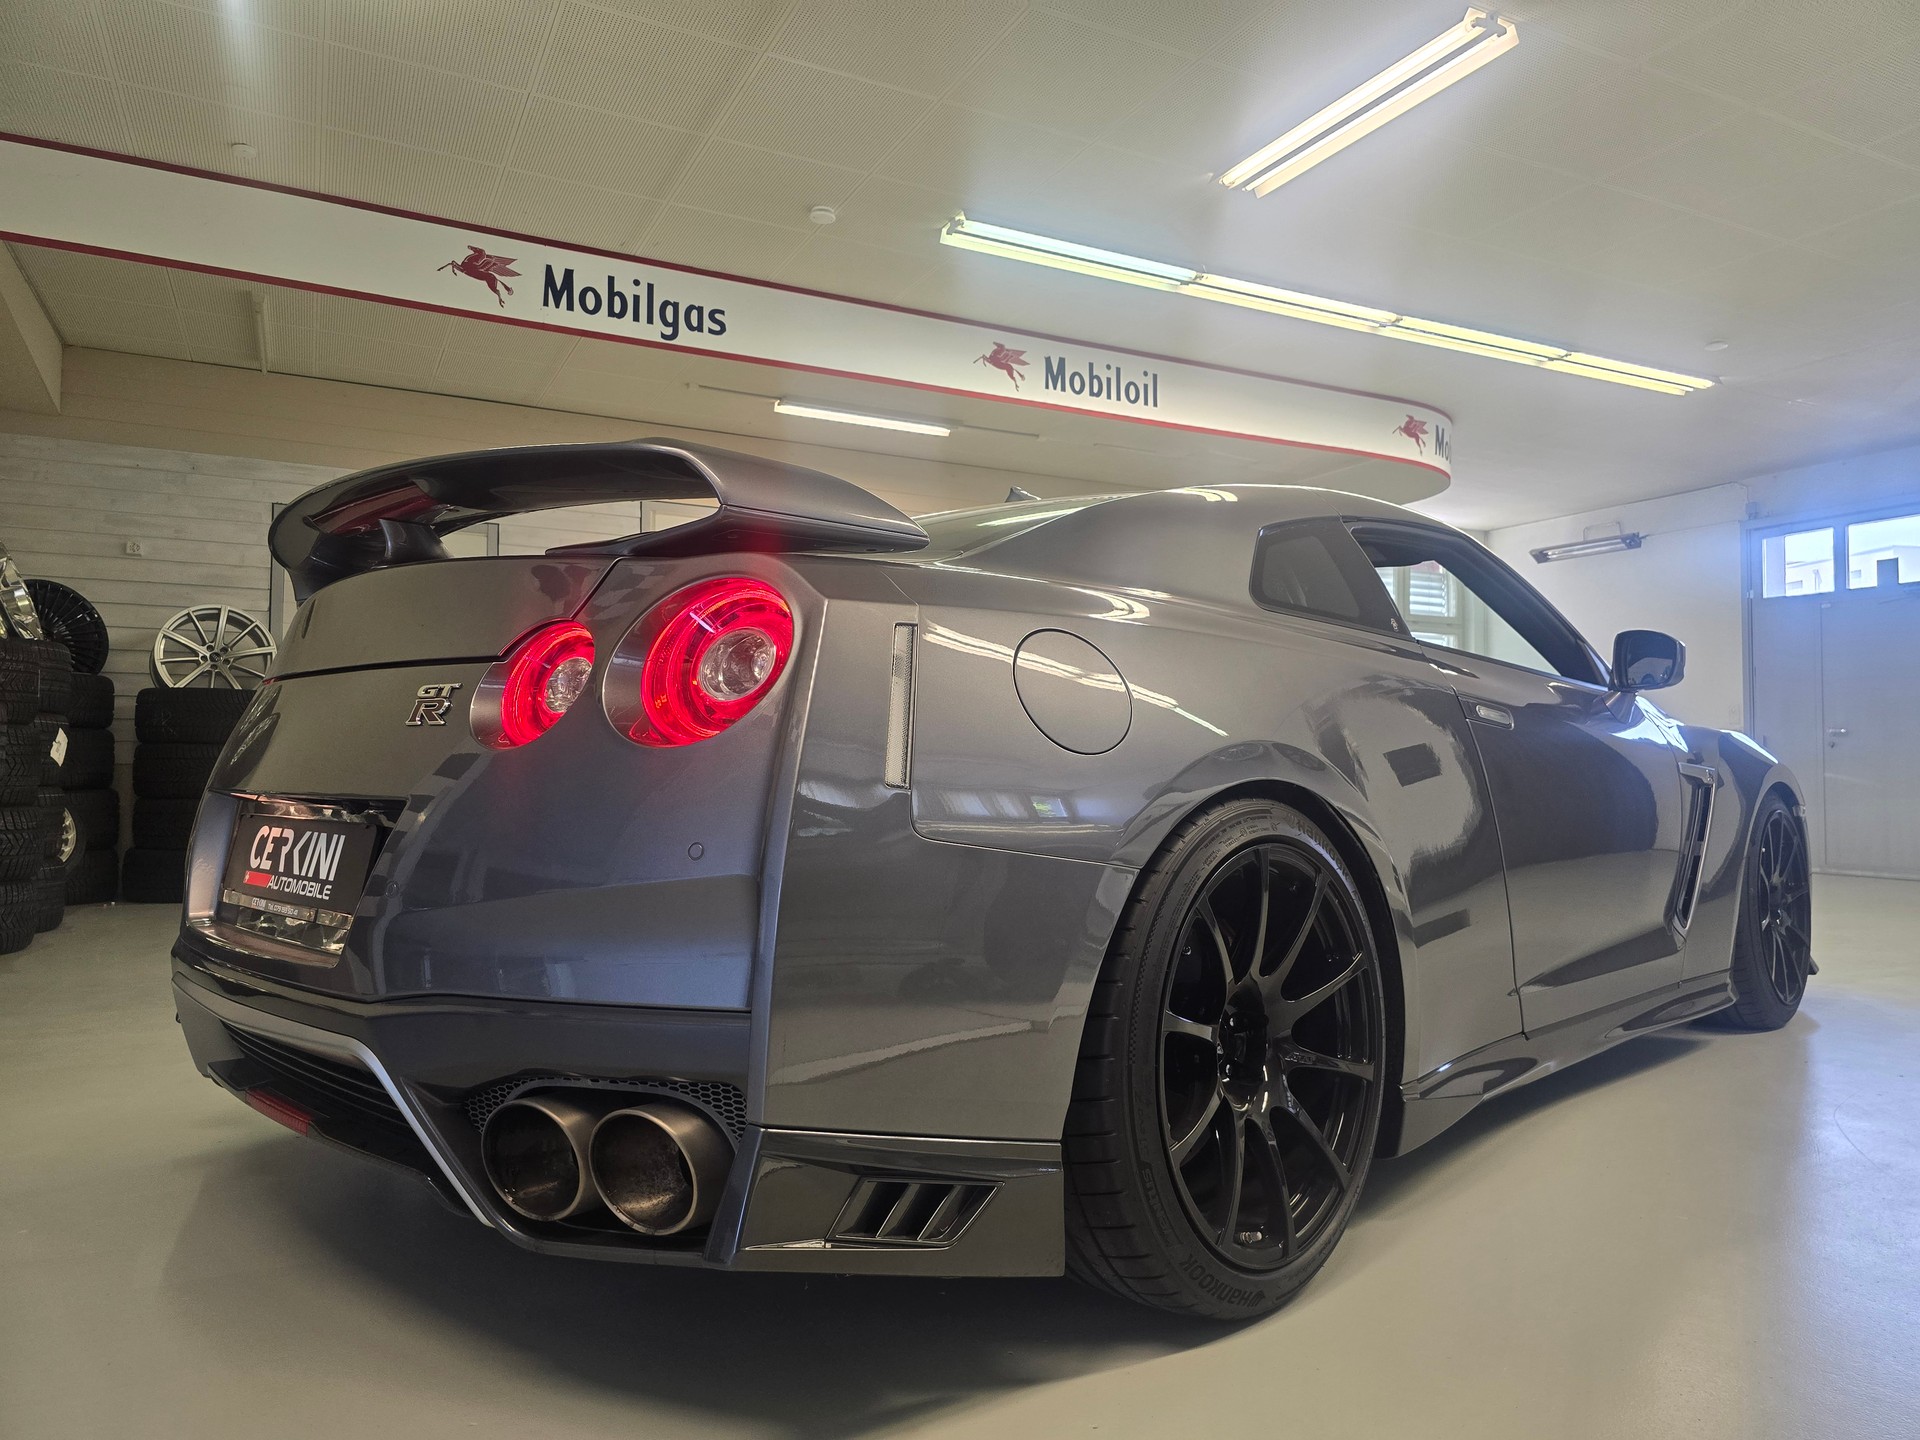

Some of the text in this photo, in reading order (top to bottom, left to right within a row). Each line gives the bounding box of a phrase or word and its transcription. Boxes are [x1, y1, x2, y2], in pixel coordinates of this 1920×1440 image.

[542, 264, 728, 341] Mobilgas
[1044, 356, 1159, 408] Mobiloil
[250, 825, 346, 882] CERKINI
[267, 874, 332, 900] AUTOMOBILE
